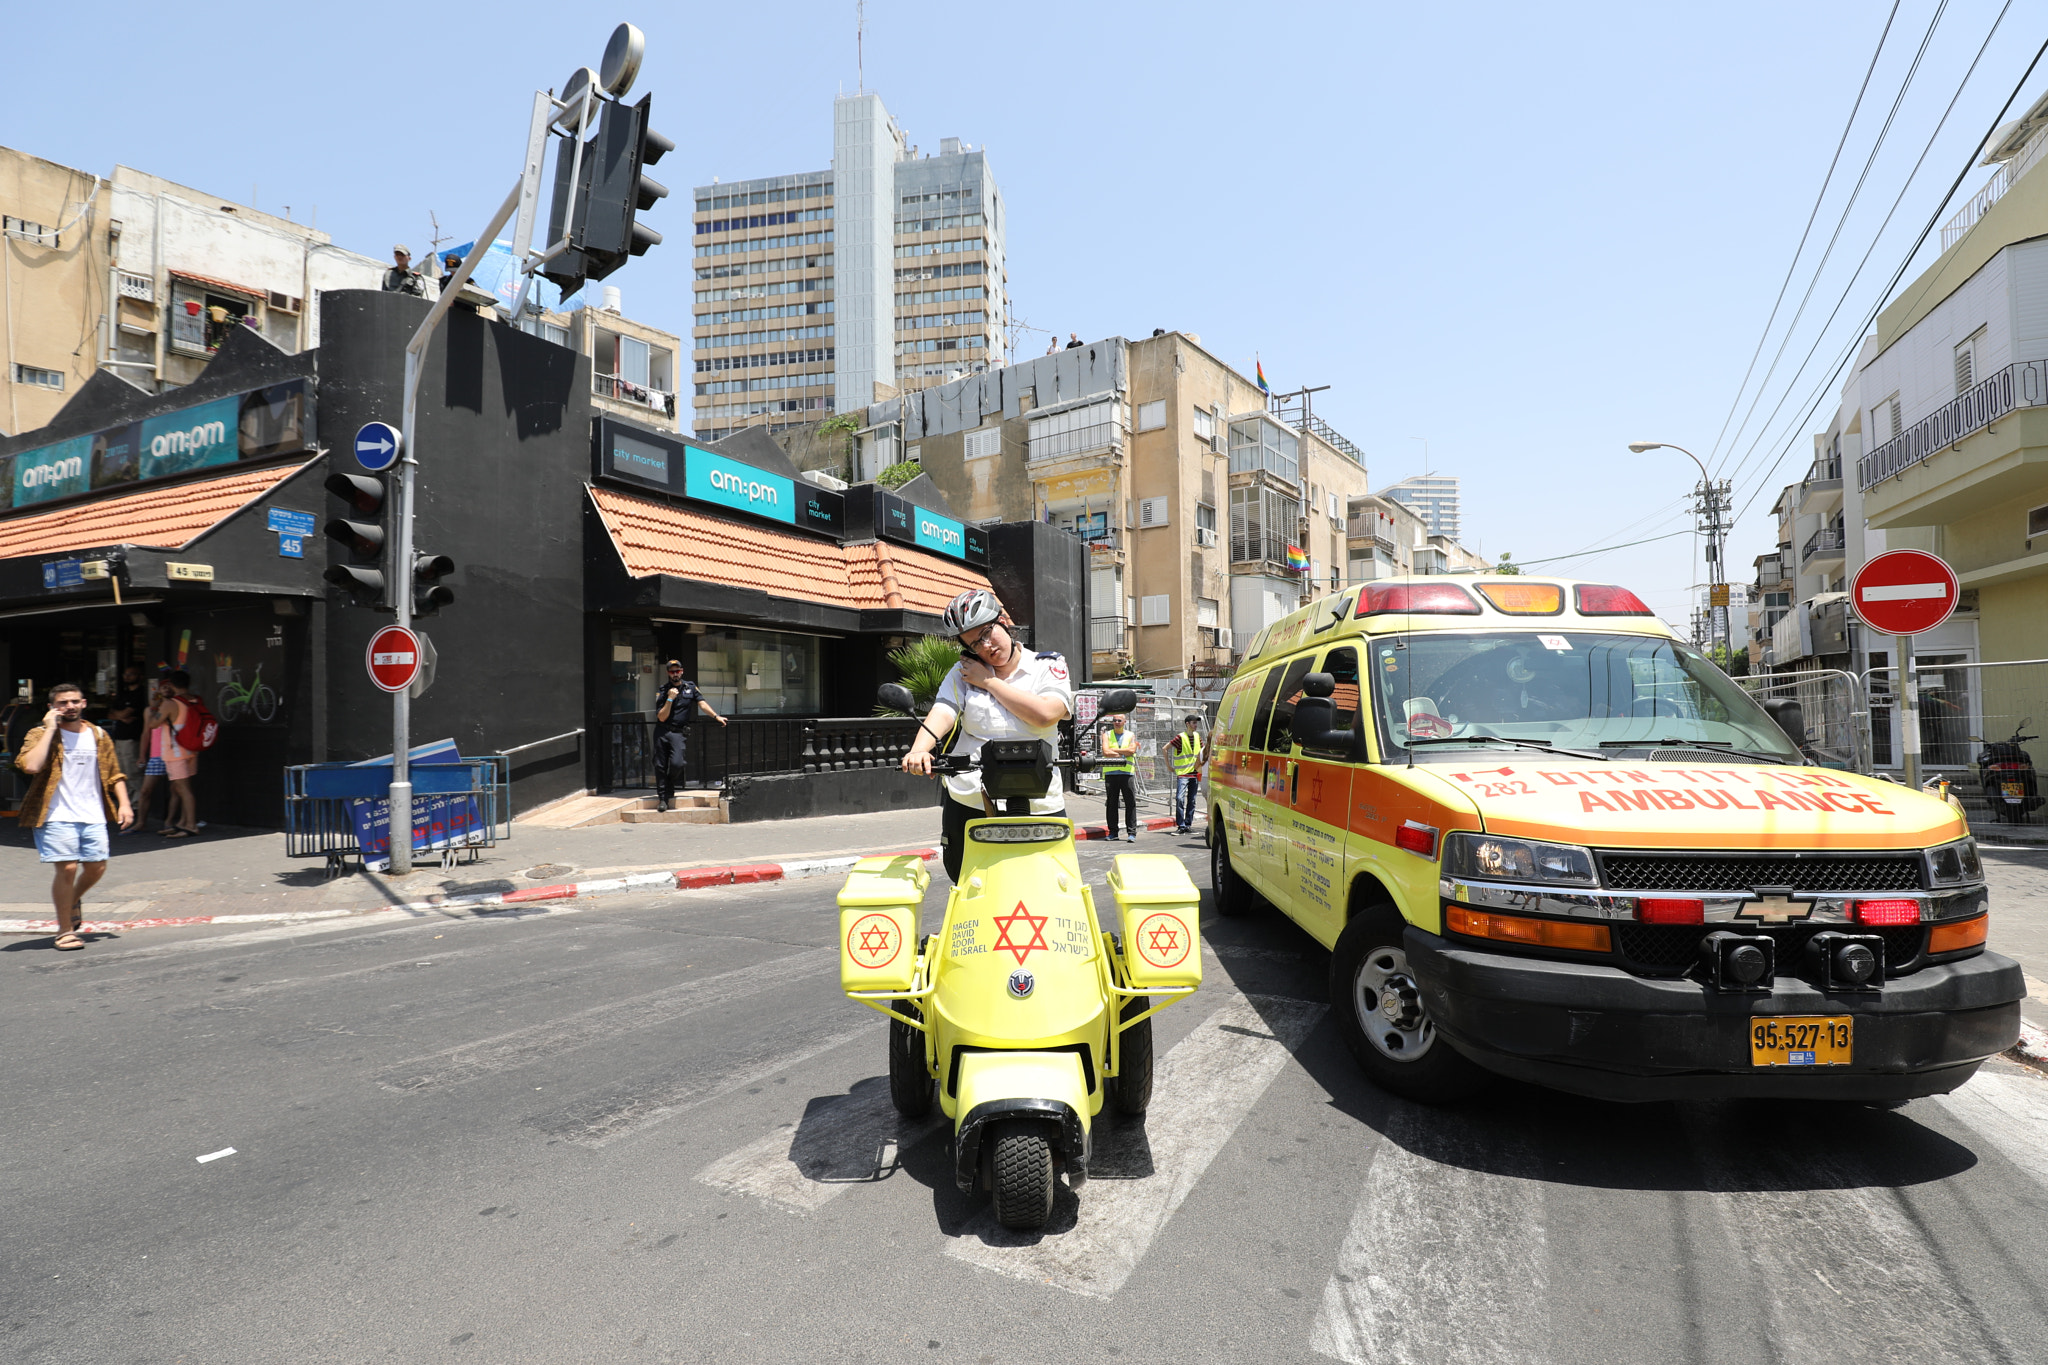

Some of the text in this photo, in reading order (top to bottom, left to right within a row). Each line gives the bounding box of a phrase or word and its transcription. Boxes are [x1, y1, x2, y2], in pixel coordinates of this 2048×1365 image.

[151, 421, 225, 457] am:pm
[613, 448, 666, 470] city market
[22, 456, 82, 488] am:pm
[710, 469, 777, 505] am:pm
[808, 499, 820, 510] city
[808, 508, 832, 522] market
[281, 539, 301, 553] 45
[969, 537, 977, 545] city
[969, 544, 984, 555] market
[176, 567, 188, 577] 45
[1536, 769, 1852, 789] מגן דוד אדום
[1474, 781, 1538, 798] 282
[1578, 789, 1896, 815] AMBULANCE
[952, 919, 979, 932] MAGEN
[1055, 917, 1088, 933] מגן דוד
[951, 929, 975, 941] DAVID
[1066, 931, 1089, 944] אדום
[951, 937, 975, 949] ADOM
[1052, 940, 1089, 957] בישראל
[950, 944, 988, 958] IN ISRAEL
